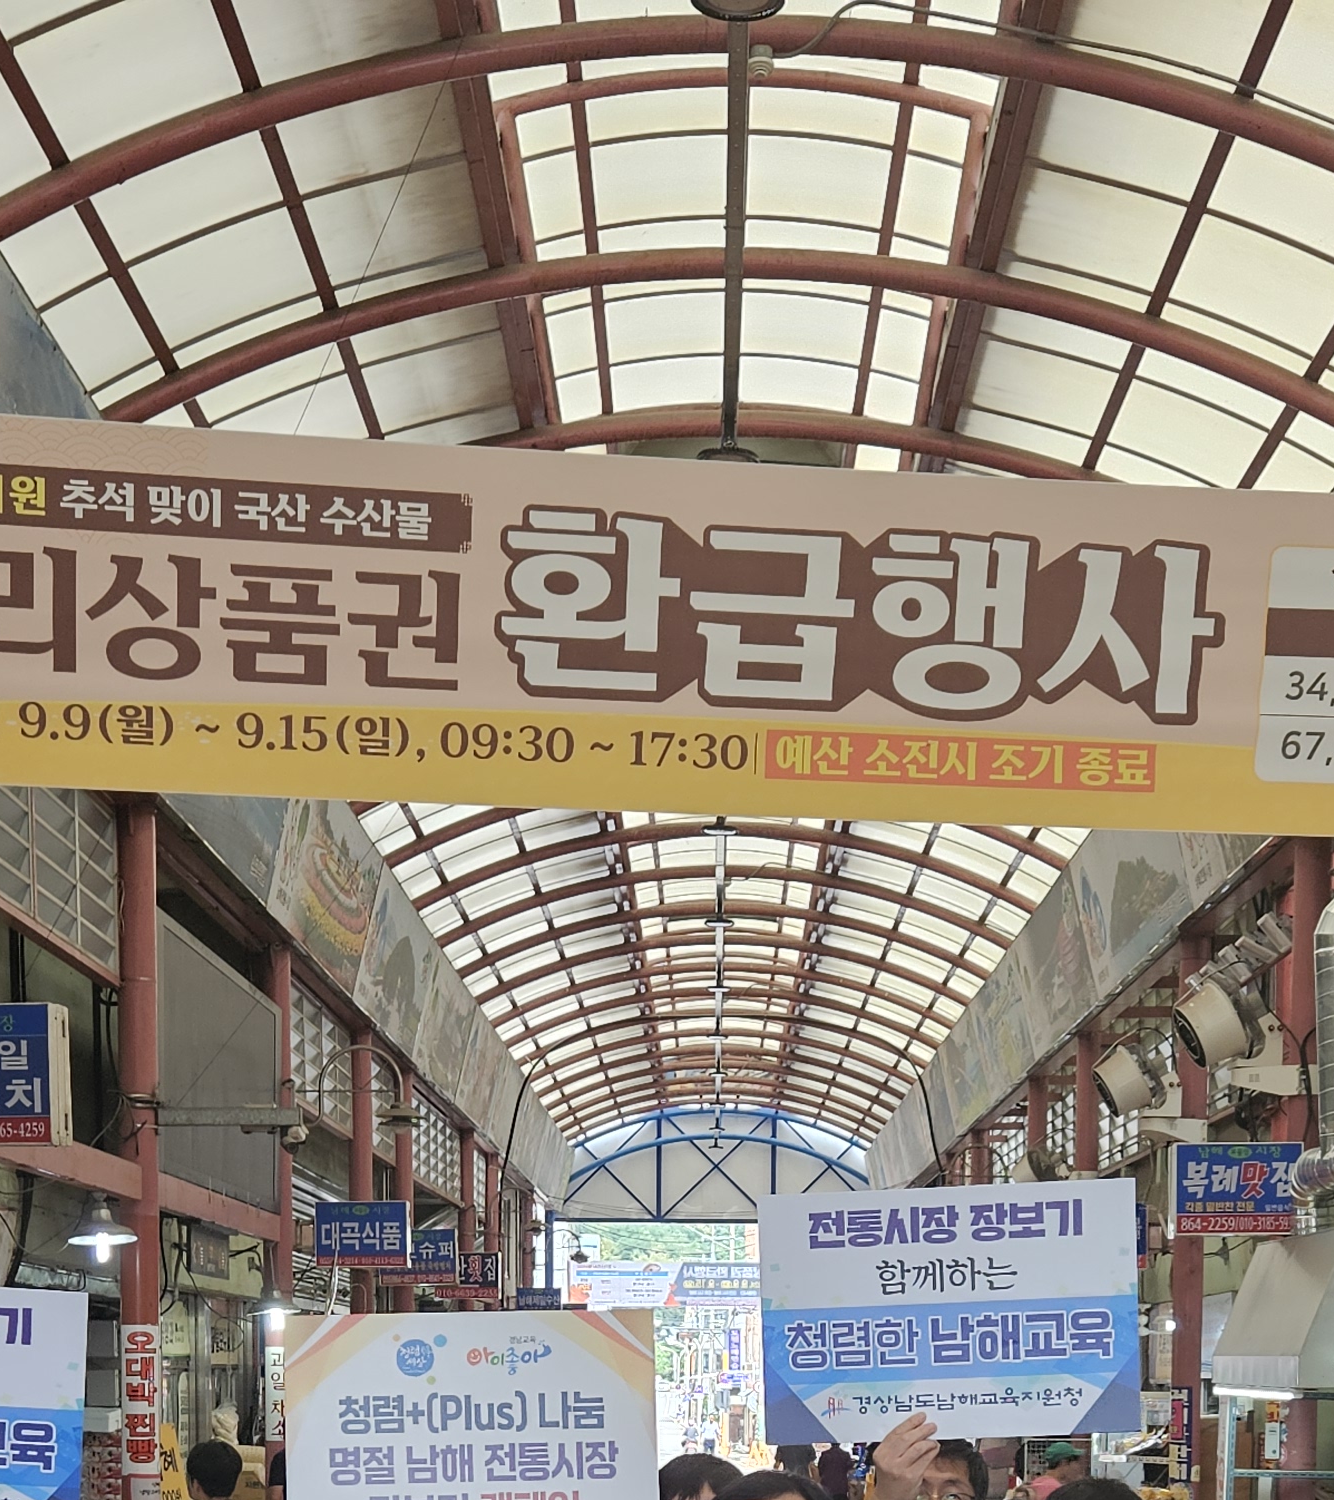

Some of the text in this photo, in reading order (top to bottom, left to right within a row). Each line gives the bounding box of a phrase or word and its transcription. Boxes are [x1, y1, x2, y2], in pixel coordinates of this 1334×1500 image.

[59, 477, 136, 526] 추석
[147, 484, 224, 530] 맞이
[234, 490, 311, 535] 국산
[319, 494, 432, 541] 수산물
[494, 504, 1226, 727] 환급행사
[17, 700, 175, 747] 9.9(월)
[235, 713, 427, 764] 9.15(일),
[439, 720, 580, 767] 09:30
[627, 729, 750, 775] 17:30
[773, 733, 1153, 789] 예산 소진시 조기 종료
[320, 1221, 402, 1252] 대곡식품
[808, 1204, 959, 1250] 전통시장
[969, 1198, 1084, 1243] 장보기
[875, 1256, 1018, 1296] 함께하는
[784, 1315, 920, 1372] 청렴한
[927, 1308, 1116, 1366] 남해교육
[124, 1330, 158, 1408] 오대박
[338, 1391, 605, 1435] 청렴+(Plus) 나눔
[851, 1386, 1084, 1416] 경상남도남해교육지원청
[124, 1412, 158, 1464] 찐빵
[328, 1440, 619, 1487] 명절 남해 전통시장
